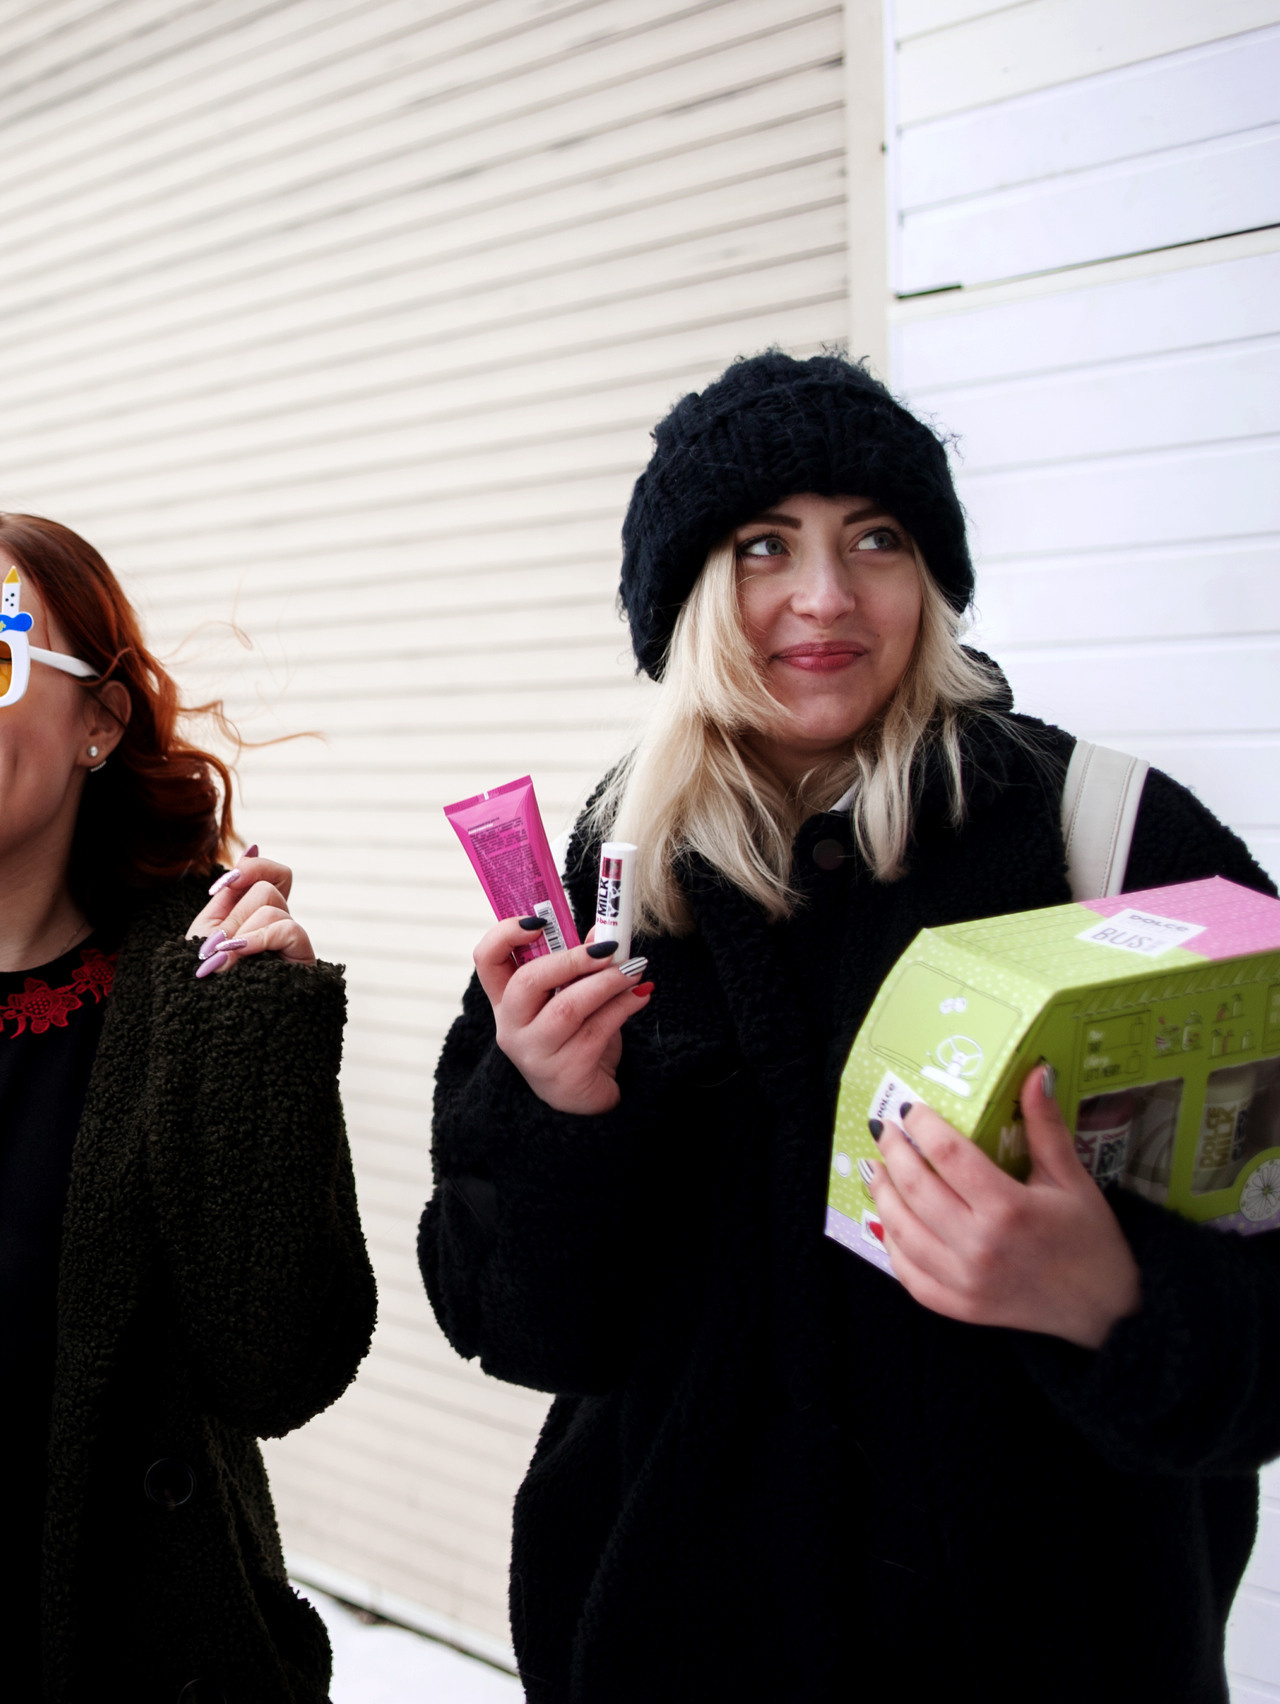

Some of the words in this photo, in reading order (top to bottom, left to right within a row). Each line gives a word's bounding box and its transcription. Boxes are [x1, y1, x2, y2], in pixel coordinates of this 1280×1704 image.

[597, 877, 609, 917] MILK
[1091, 927, 1153, 949] BUS
[1199, 1107, 1220, 1168] DOLCE
[1213, 1105, 1236, 1168] MILK
